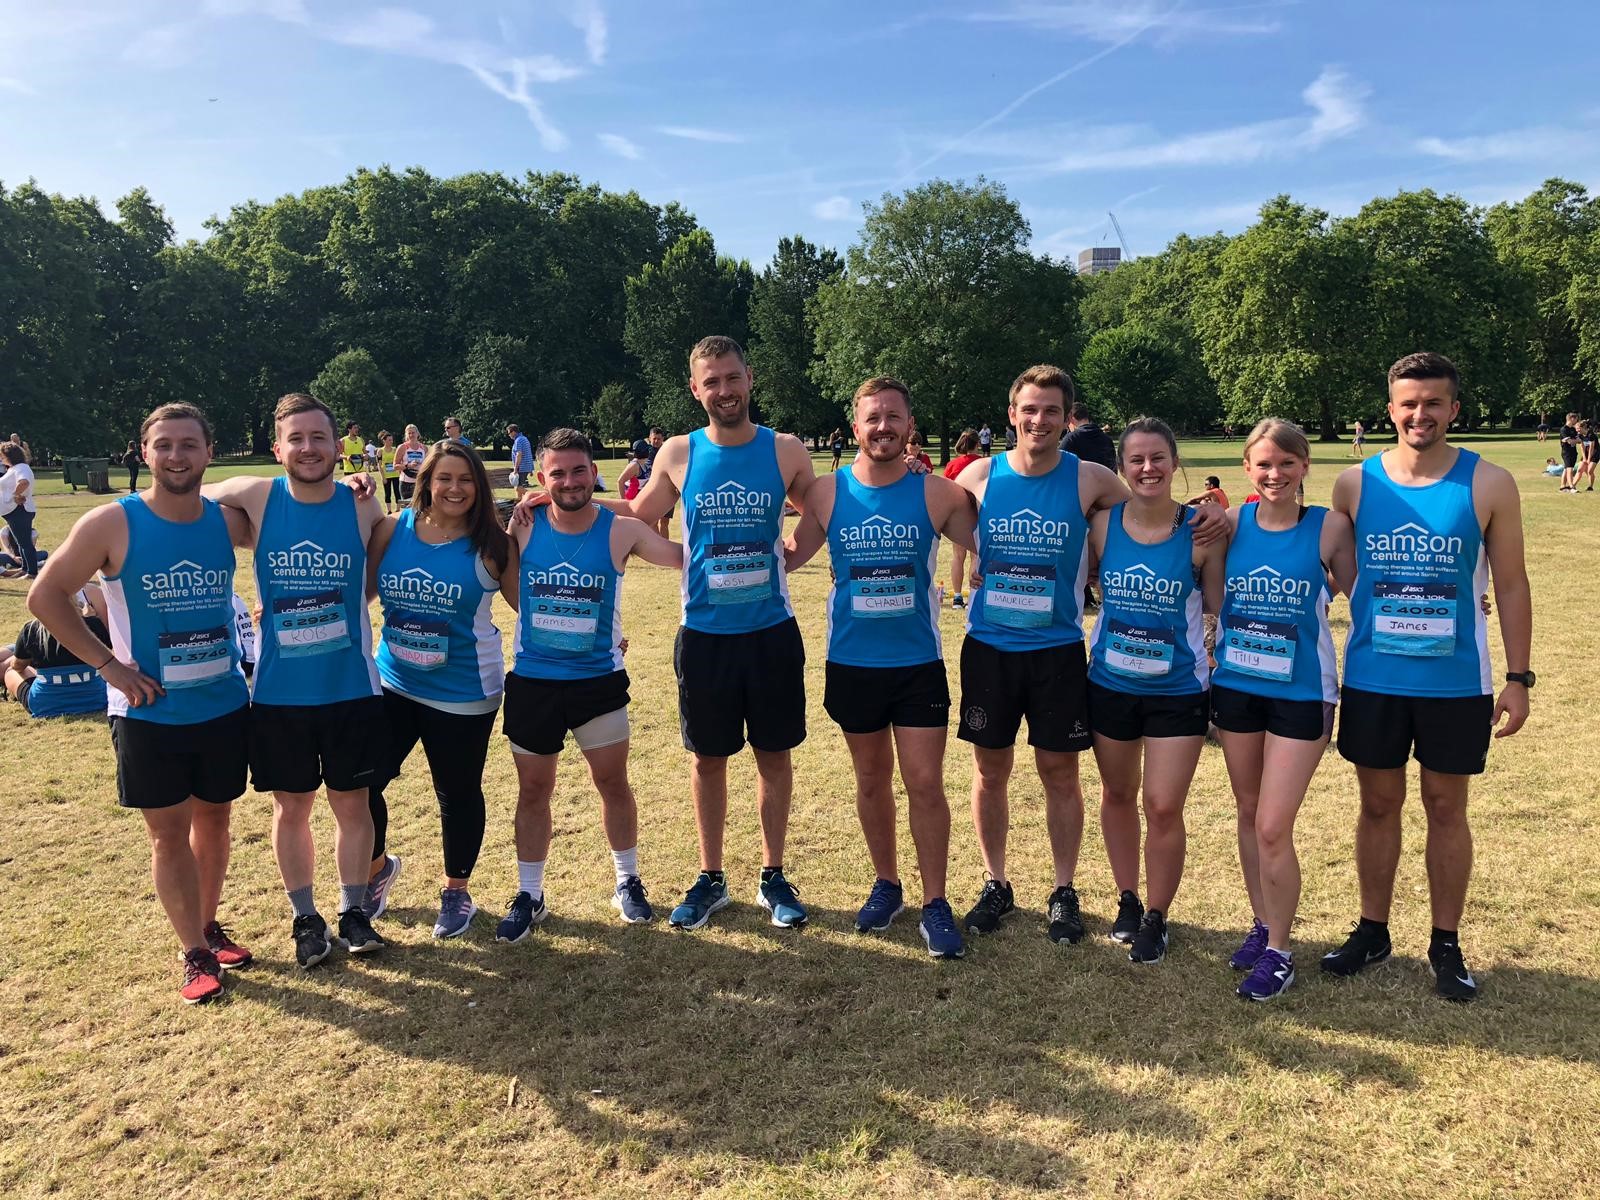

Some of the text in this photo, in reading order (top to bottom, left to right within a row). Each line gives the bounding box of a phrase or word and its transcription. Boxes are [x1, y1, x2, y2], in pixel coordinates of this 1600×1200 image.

[695, 491, 771, 508] samson
[702, 506, 764, 516] centre for ms
[840, 524, 919, 542] samson
[988, 518, 1069, 537] samson
[846, 540, 877, 550] centre
[881, 539, 896, 548] for
[992, 534, 1025, 542] centre
[1028, 534, 1044, 544] for
[1366, 534, 1462, 554] samson
[268, 551, 351, 569] samson
[1372, 552, 1454, 563] centre for ms
[274, 567, 306, 576] centre
[310, 567, 326, 577] for
[726, 561, 765, 571] 6943
[142, 570, 228, 590] samson
[381, 573, 462, 599] samson
[528, 571, 605, 589] samson
[716, 579, 744, 587] JOSH
[1104, 571, 1182, 596] samson
[1227, 576, 1310, 596] samson
[150, 588, 188, 599] centre
[192, 586, 208, 596] for
[875, 585, 906, 593] 4113
[1009, 584, 1046, 593] 4107
[385, 590, 416, 600] centre
[420, 593, 434, 602] for
[438, 597, 454, 606] ms
[866, 597, 912, 607] CHARLIE
[994, 595, 1035, 606] MAURICE
[1108, 588, 1175, 604] centre for ms
[1235, 592, 1301, 605] centre for ms
[552, 606, 591, 615] 3734
[297, 612, 339, 626] 2923
[536, 617, 575, 628] JAMES
[392, 626, 424, 636] LONDON
[1233, 626, 1267, 637] LONDON
[1390, 621, 1427, 630] JAMES
[291, 627, 327, 642] ROB
[1114, 631, 1146, 643] LONDON
[401, 639, 440, 649] 9484
[1242, 641, 1287, 654] 3444
[187, 648, 227, 661] 3740
[1126, 646, 1162, 657] 6919
[1122, 657, 1144, 669] CAZ
[1233, 651, 1259, 665] Tilly
